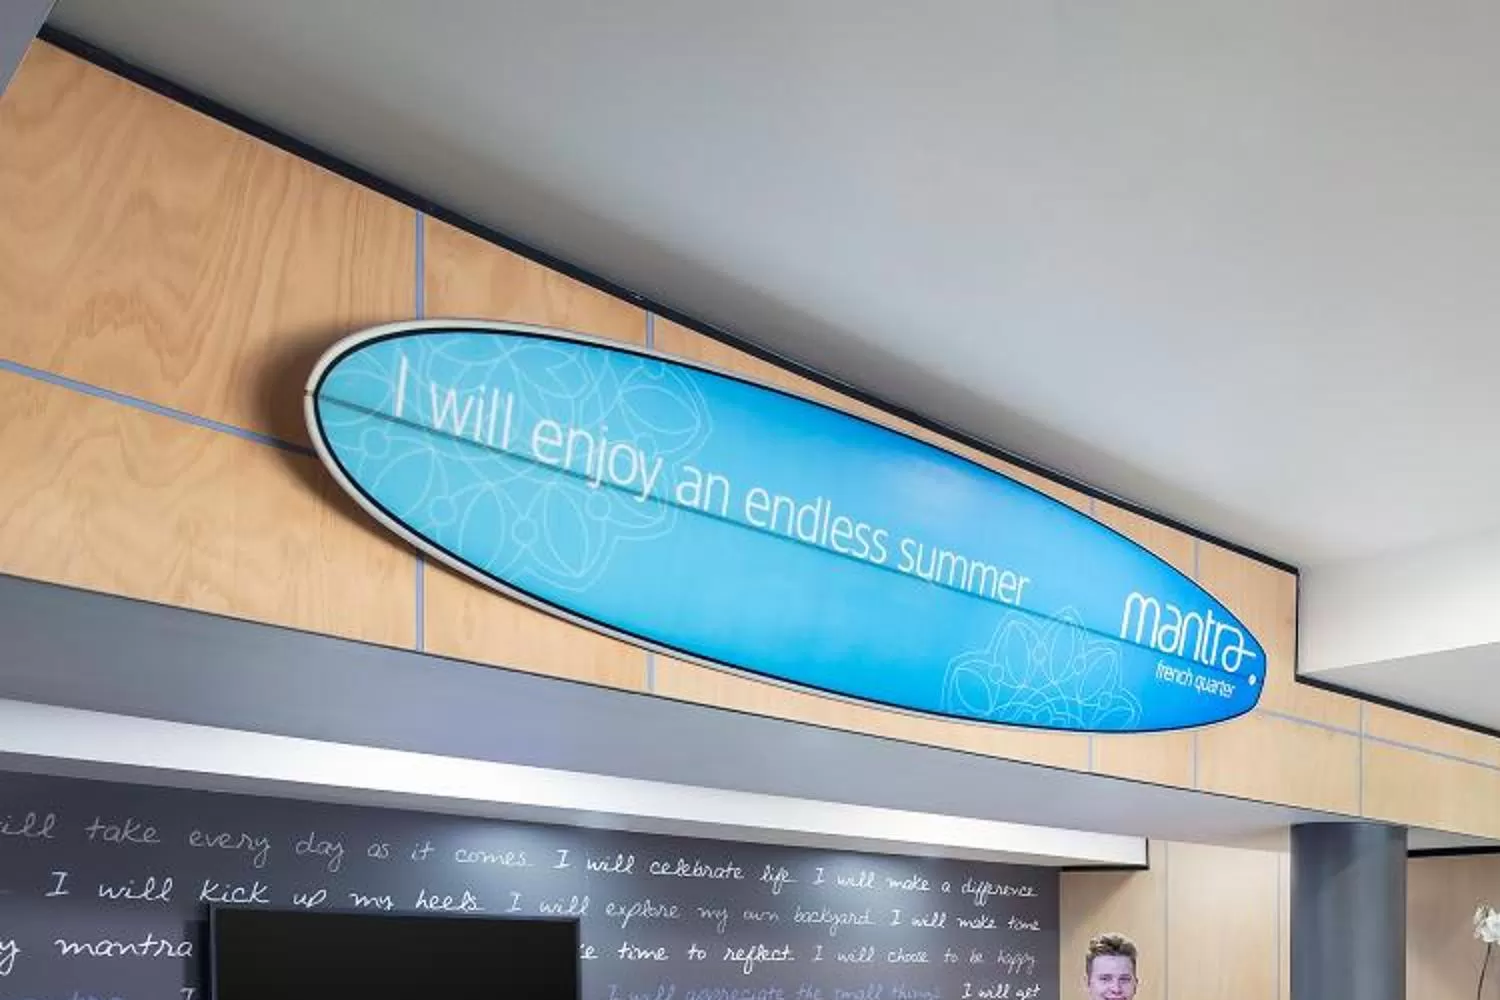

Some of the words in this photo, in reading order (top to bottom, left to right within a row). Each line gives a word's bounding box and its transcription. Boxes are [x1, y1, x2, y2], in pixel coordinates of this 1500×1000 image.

[395, 353, 409, 418] I
[430, 381, 514, 450] will
[531, 418, 664, 503] enjoy
[674, 464, 730, 518] an
[744, 485, 890, 564] endless
[896, 537, 1032, 607] summer
[1119, 590, 1257, 673] mantra
[1155, 659, 1193, 687] french
[1193, 675, 1236, 699] quarter
[0, 811, 56, 840] ill
[83, 814, 162, 844] take
[188, 827, 272, 869] every
[295, 831, 345, 873] day
[366, 841, 390, 859] as
[410, 839, 436, 861] it
[454, 848, 530, 869] comes
[551, 848, 571, 870] I
[586, 852, 636, 875] will
[648, 857, 746, 880] celebrate
[810, 866, 825, 885] I
[836, 870, 876, 890] will
[885, 873, 931, 892] make
[940, 881, 952, 894] a
[960, 875, 1039, 907] difference
[44, 870, 71, 898] I
[98, 875, 174, 902] will
[292, 888, 328, 909] up
[349, 892, 395, 911] my
[503, 891, 524, 913] I
[538, 895, 591, 917] will
[605, 899, 682, 930] explore
[697, 905, 730, 935] my
[742, 908, 780, 924] own
[793, 904, 875, 937] backyard
[888, 907, 902, 926] I
[911, 911, 948, 930] will
[955, 913, 998, 931] make
[1006, 915, 1042, 932] time
[52, 931, 194, 958] mantra
[617, 940, 670, 962] time
[686, 942, 708, 962] to
[810, 944, 824, 964] I
[836, 946, 877, 964] will
[886, 947, 930, 964] choose
[942, 947, 960, 965] to
[968, 948, 986, 965] be
[996, 948, 1037, 976] happy
[960, 982, 973, 1000] I
[977, 982, 1011, 1000] will
